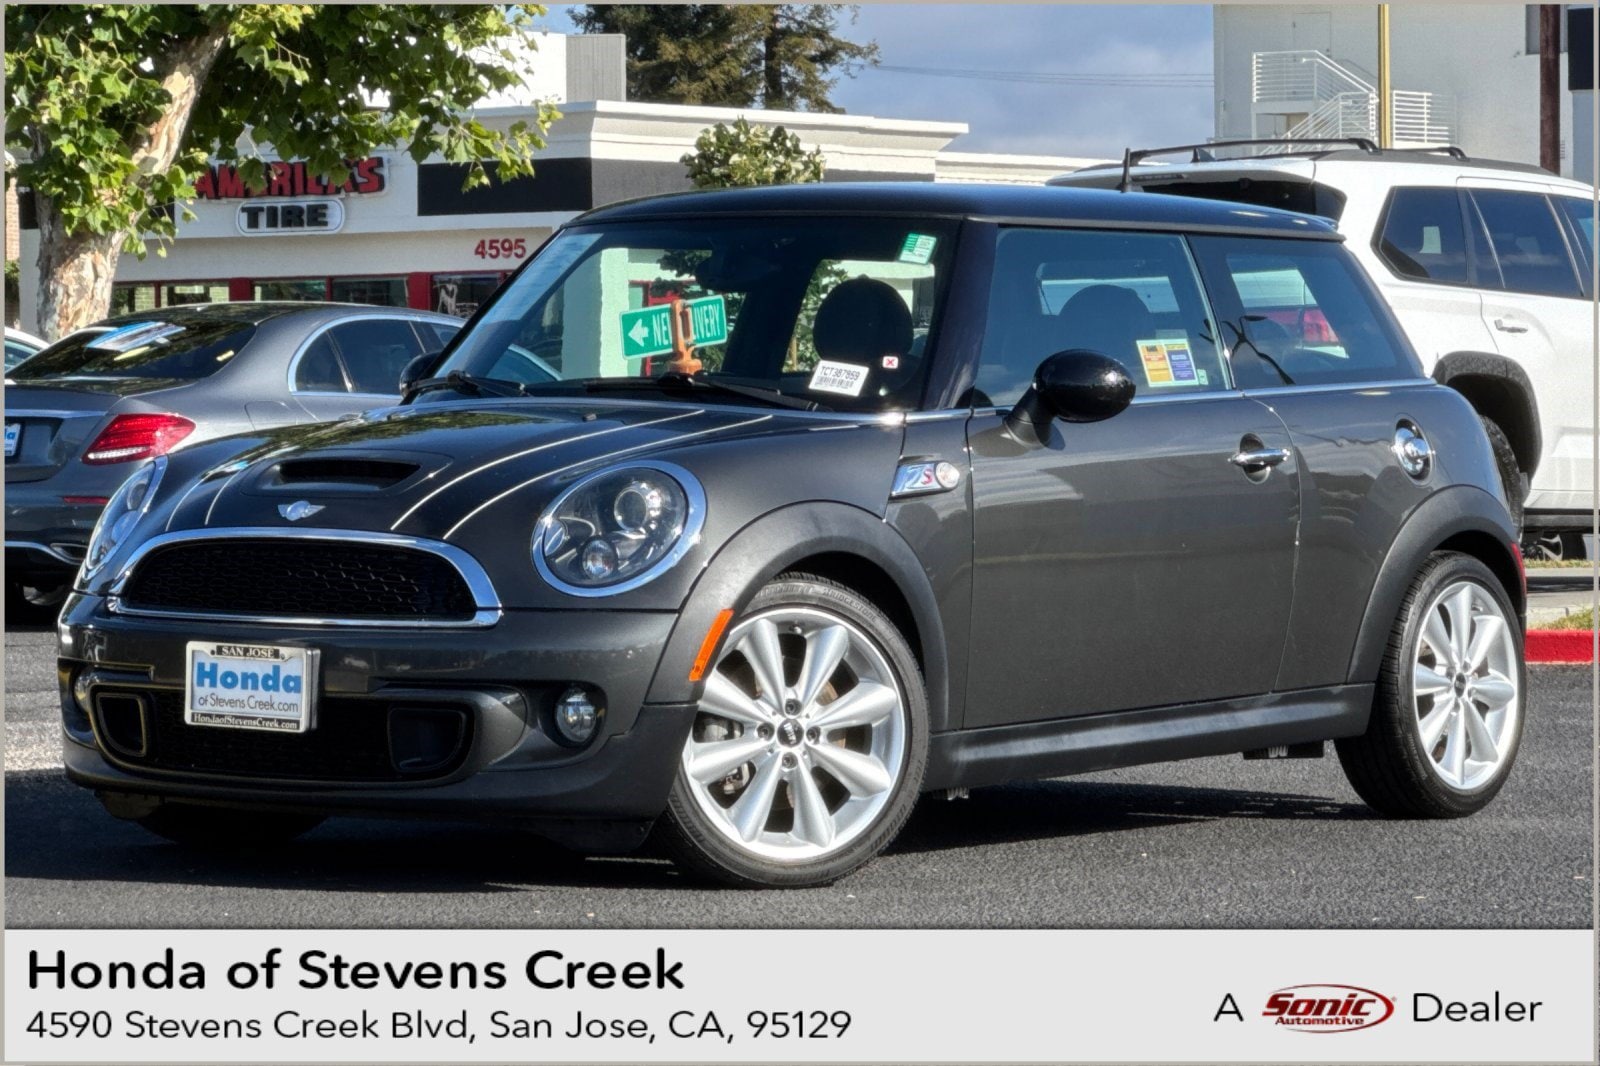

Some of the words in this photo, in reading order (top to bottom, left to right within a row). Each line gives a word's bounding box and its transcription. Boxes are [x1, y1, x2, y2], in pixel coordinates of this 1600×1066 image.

[241, 204, 328, 229] TIRE
[474, 238, 526, 259] 4595
[692, 303, 721, 340] IVERY
[221, 645, 245, 657] SAN
[196, 662, 302, 694] Honda
[198, 694, 209, 706] of
[193, 713, 298, 730] HondaofStevensCreek.com
